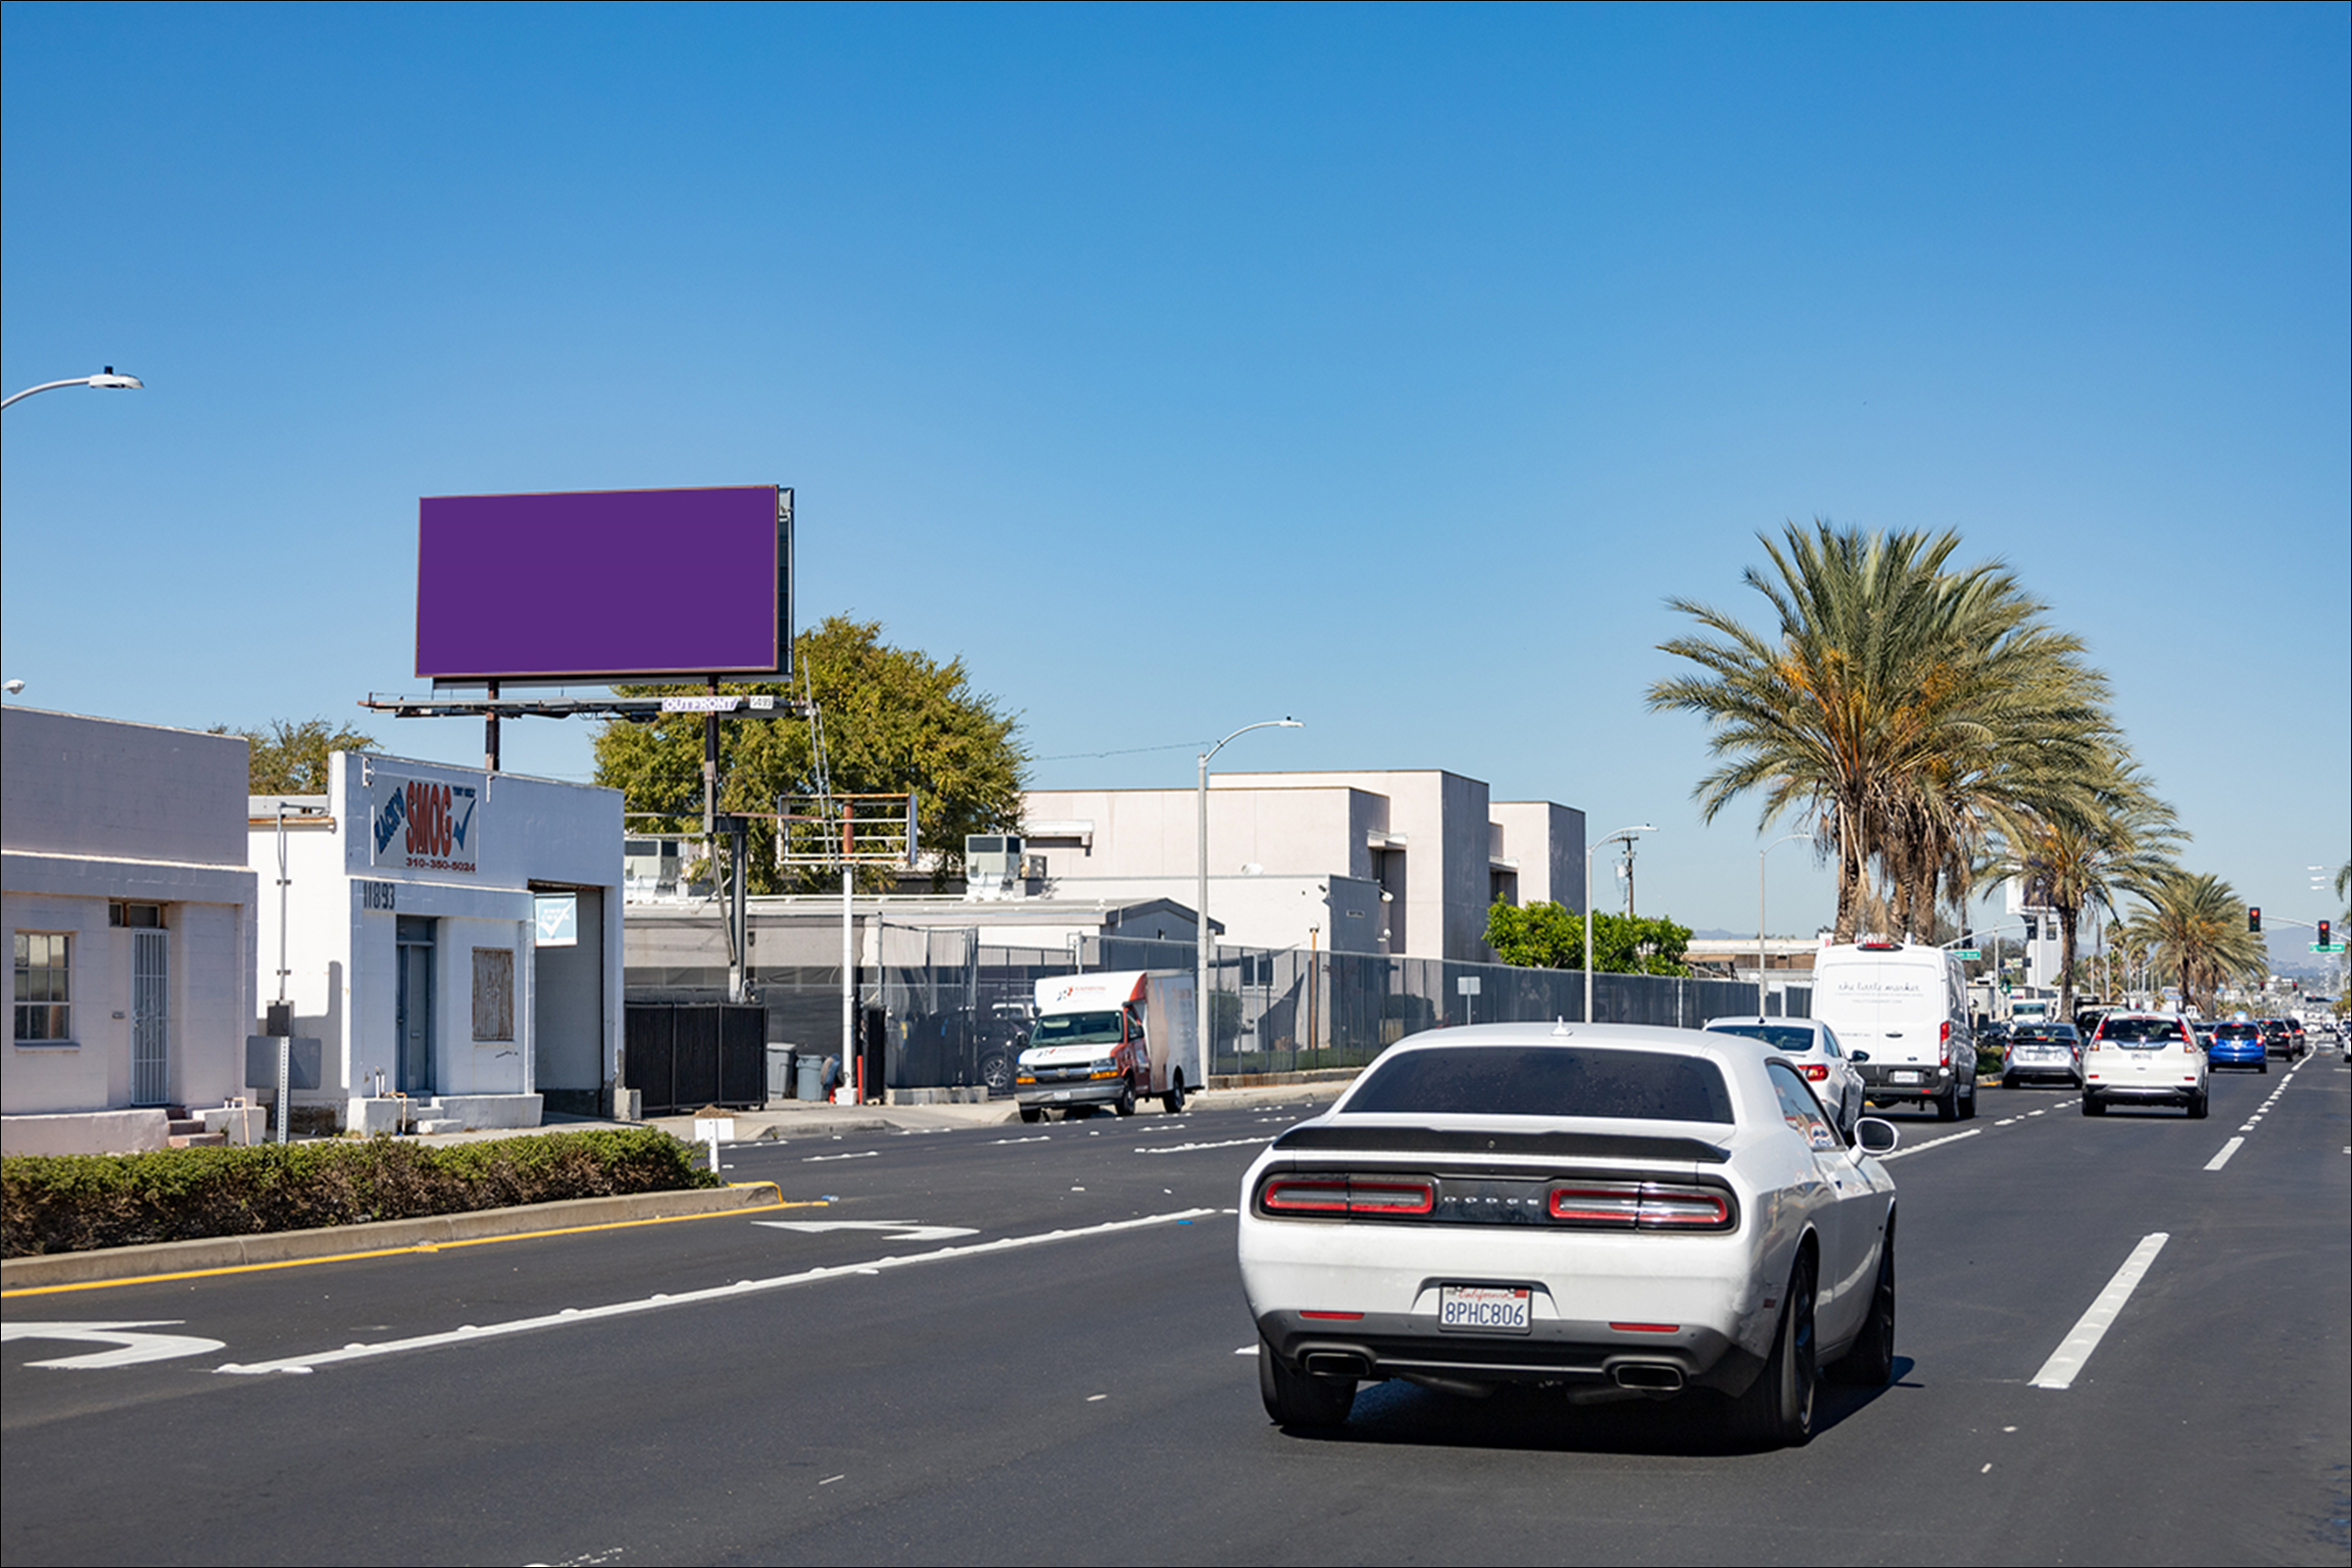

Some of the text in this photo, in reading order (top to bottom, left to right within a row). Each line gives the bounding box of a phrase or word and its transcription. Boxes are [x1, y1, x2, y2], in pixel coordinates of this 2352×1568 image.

[664, 697, 734, 710] OUTFRONT
[406, 780, 452, 858] SMOG
[406, 857, 476, 872] 310-350-5024
[363, 882, 396, 909] 11893
[1444, 1196, 1540, 1205] DODGE
[1458, 1287, 1514, 1301] California
[1445, 1301, 1525, 1326] 8PHC806
